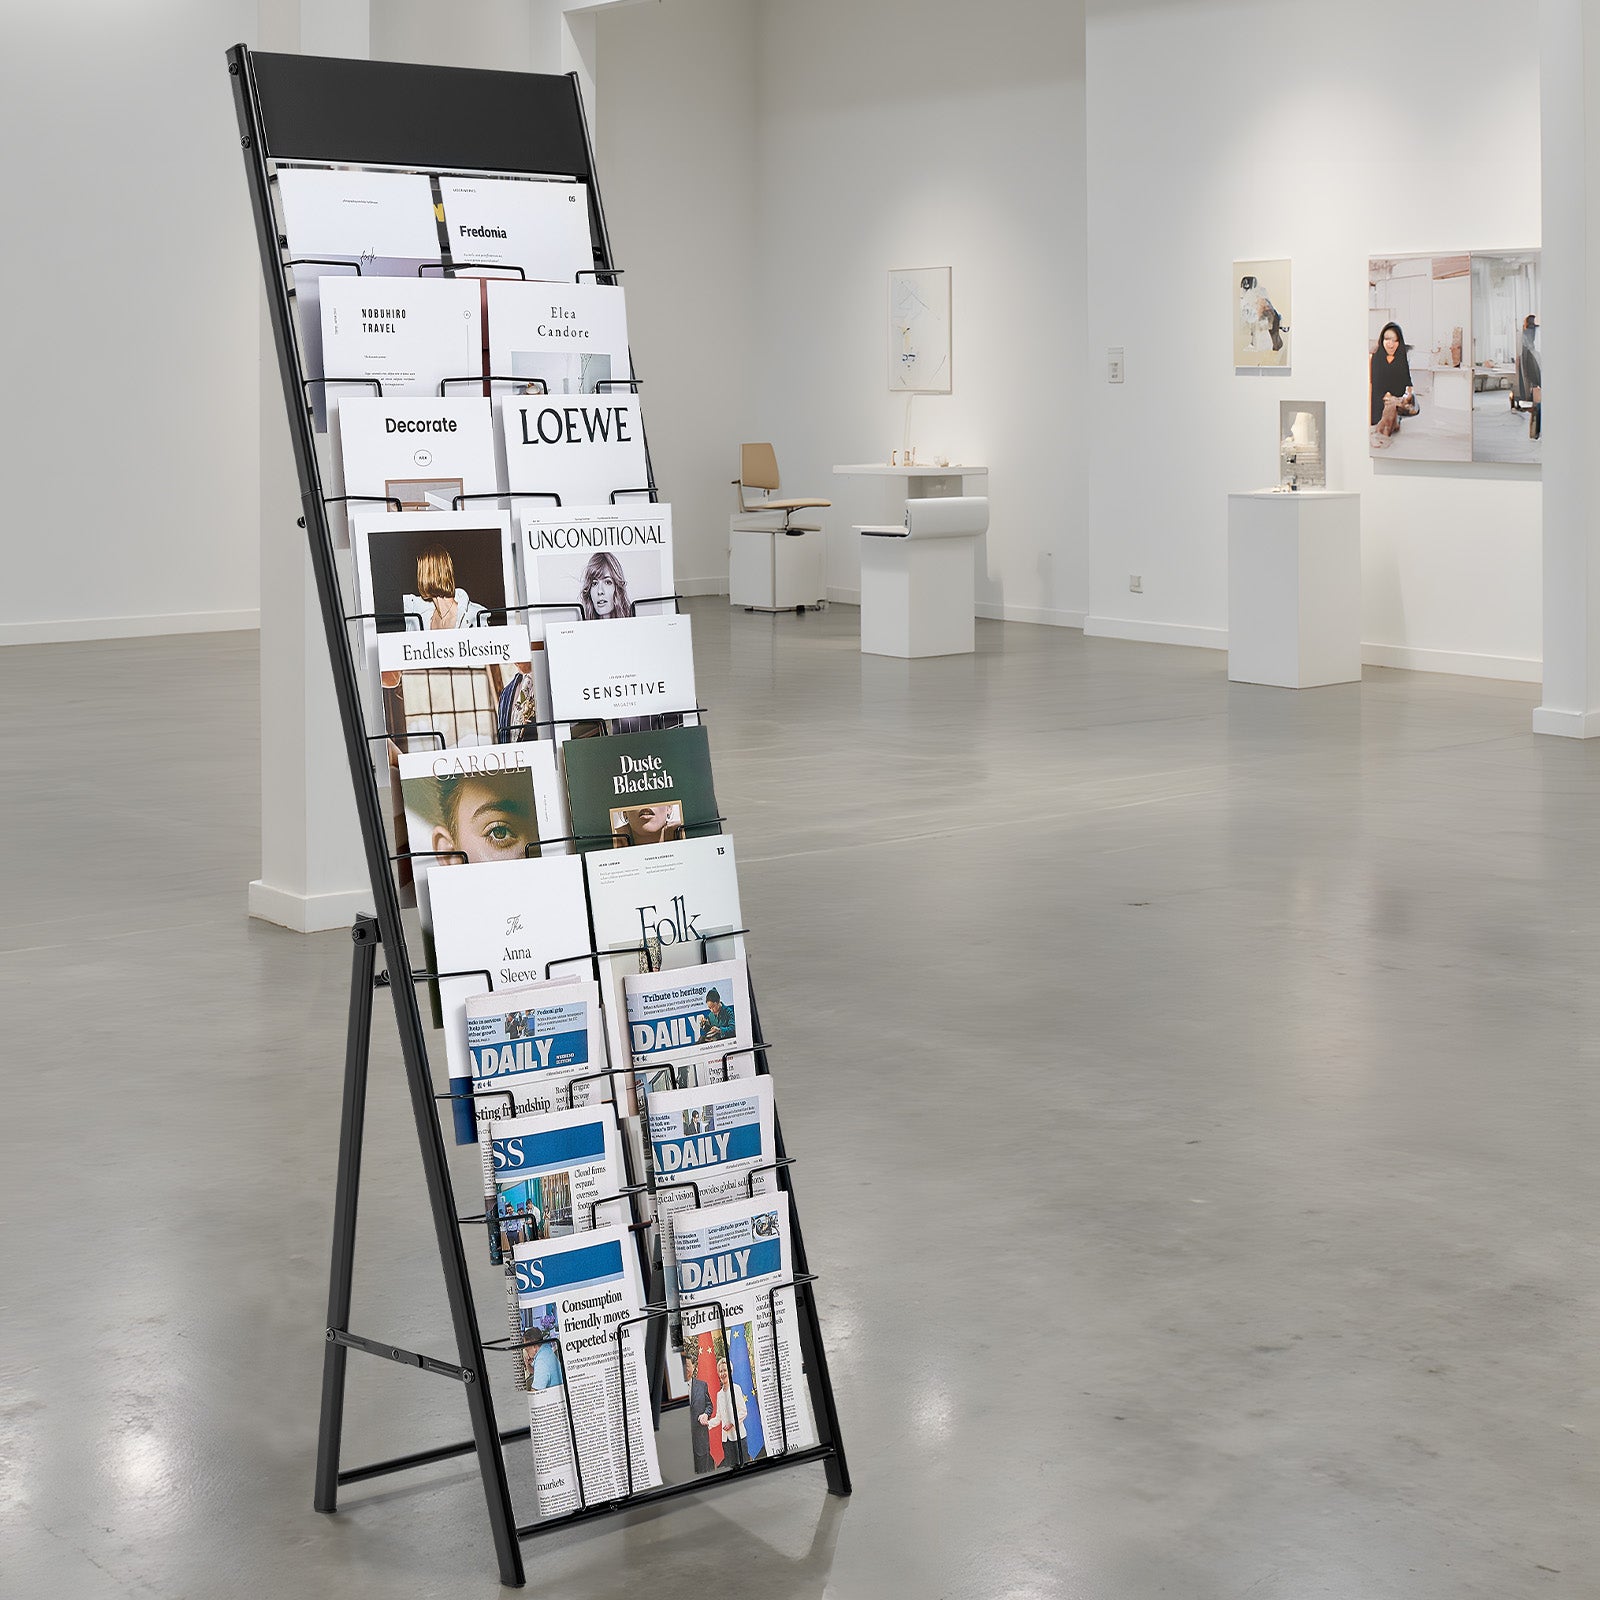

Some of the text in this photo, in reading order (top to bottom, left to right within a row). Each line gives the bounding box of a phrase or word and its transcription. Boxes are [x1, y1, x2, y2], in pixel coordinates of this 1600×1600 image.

[568, 195, 576, 203] 05
[459, 225, 508, 239] Fredonia
[361, 308, 407, 319] NOBUHIRO
[550, 306, 577, 319] Elea
[362, 323, 396, 333] TRAVEL
[537, 324, 590, 338] Candore
[385, 417, 458, 433] Decorate
[519, 407, 632, 445] LOEWE
[528, 525, 666, 550] UNCONDITIONAL
[402, 638, 511, 662] Endless Blessing
[582, 681, 666, 701] SENSITIVE
[432, 749, 527, 781] CAROLE
[619, 753, 663, 775] Duste
[612, 769, 674, 795] Blackish
[716, 847, 725, 856] 13
[505, 914, 524, 936] The
[502, 946, 532, 962] Anna
[500, 966, 538, 985] Sleeve
[642, 985, 707, 1003] Tribute to heritage
[574, 1166, 591, 1178] Cloud
[574, 1176, 595, 1190] expand
[674, 1189, 694, 1202] vision
[719, 1180, 737, 1194] global
[575, 1189, 599, 1201] overseas
[562, 1290, 623, 1314] Consumption
[564, 1309, 630, 1333] friendly moves
[565, 1329, 607, 1353] expected
[537, 1477, 565, 1492] markets
